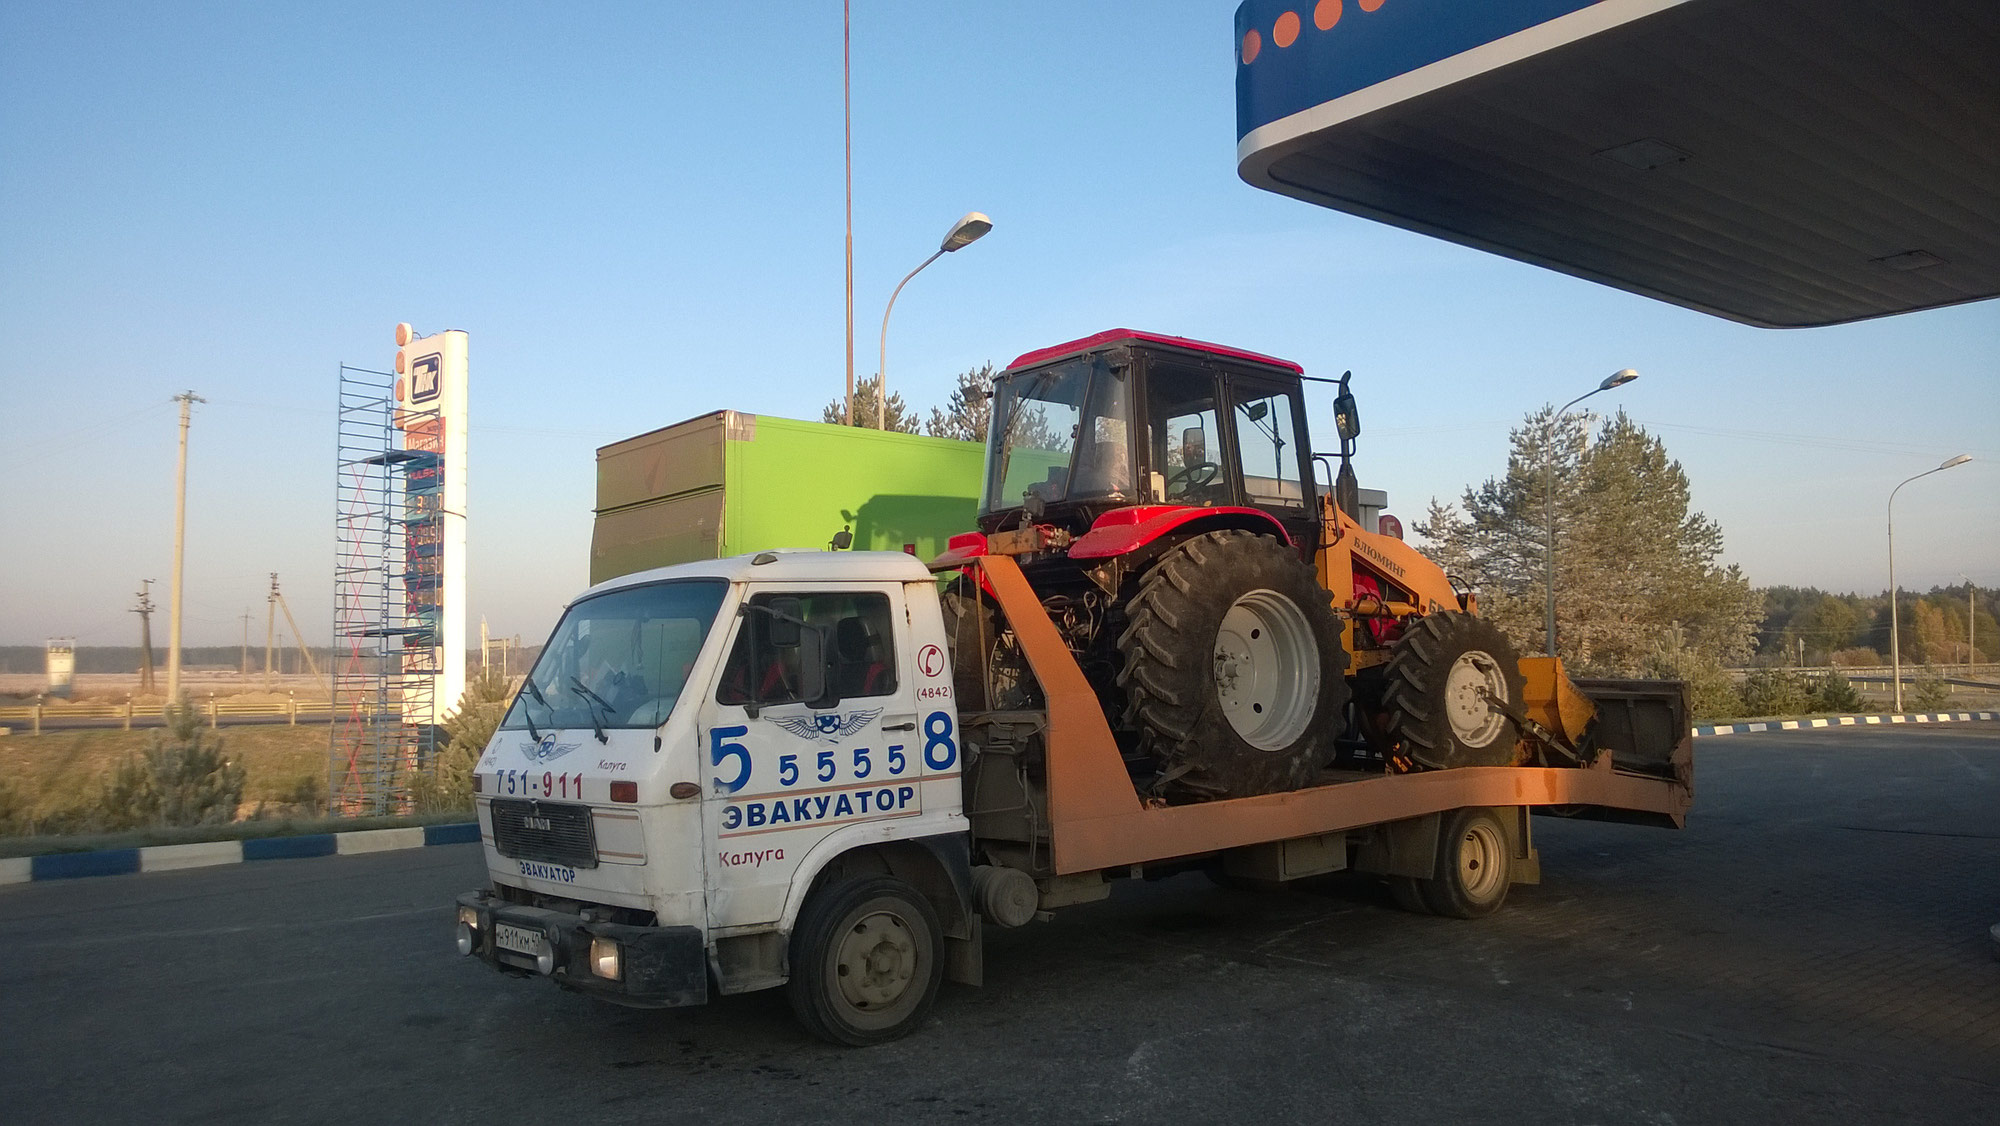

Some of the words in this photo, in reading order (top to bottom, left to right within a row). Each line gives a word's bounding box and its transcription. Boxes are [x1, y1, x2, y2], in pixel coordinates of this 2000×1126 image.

[1353, 536, 1406, 578] БЛЮМИНГ
[916, 686, 953, 701] (4842)
[598, 759, 627, 773] Калуга
[496, 769, 583, 800] 751-911
[721, 786, 914, 830] ЭВАКУАТОР
[718, 848, 785, 869] Калуга
[519, 861, 576, 883] ЭВАКУАТОР
